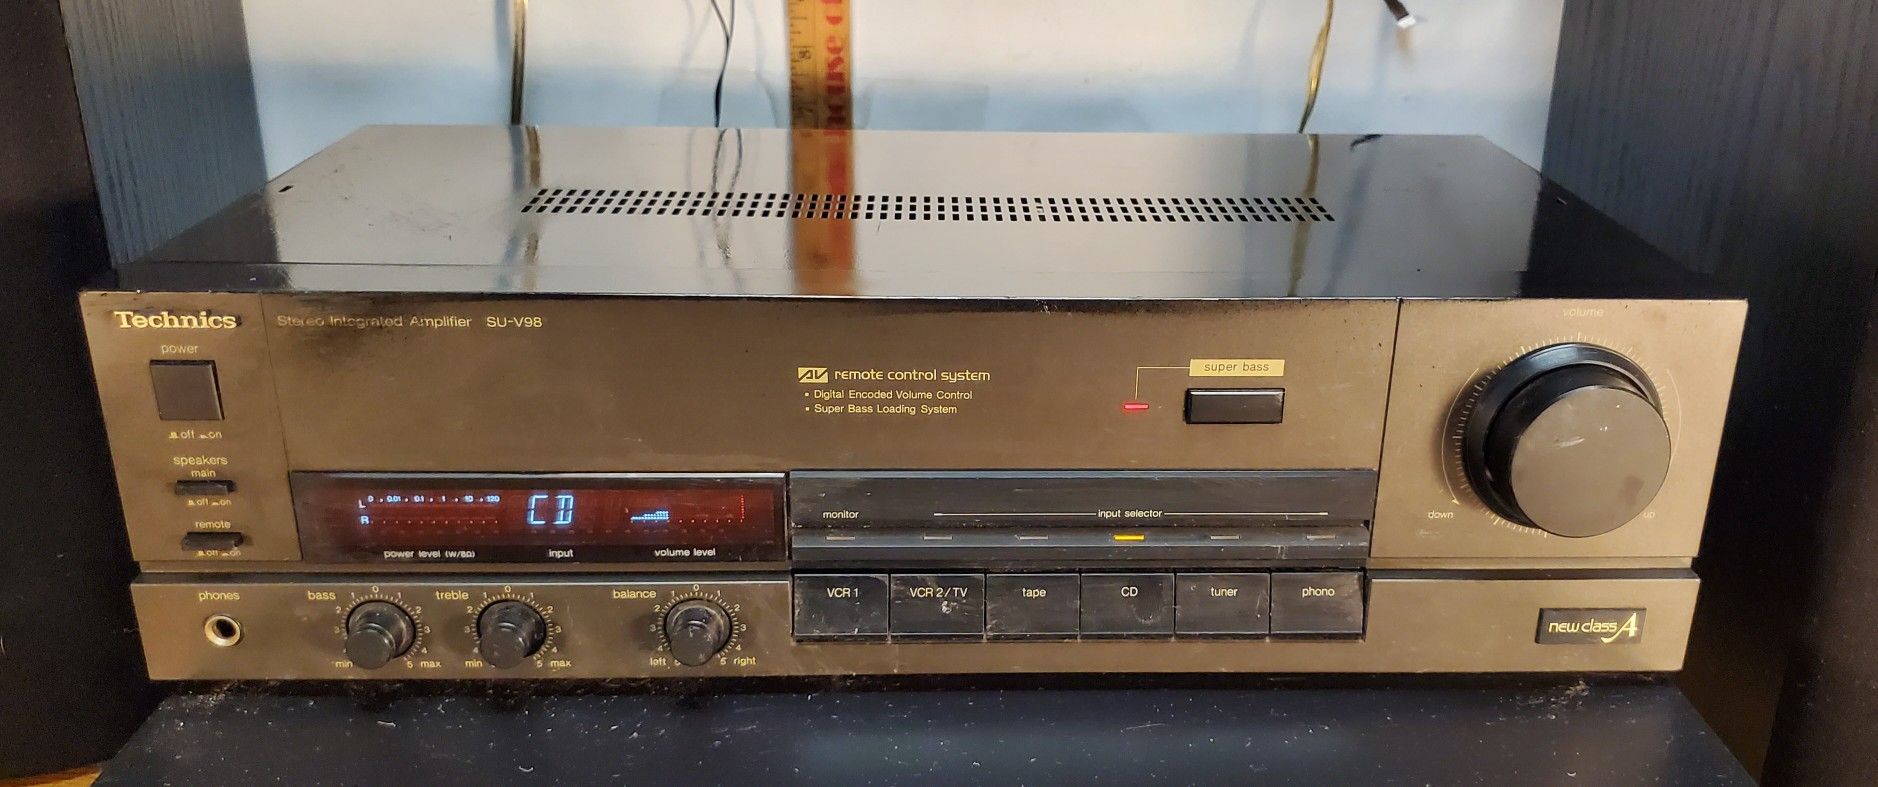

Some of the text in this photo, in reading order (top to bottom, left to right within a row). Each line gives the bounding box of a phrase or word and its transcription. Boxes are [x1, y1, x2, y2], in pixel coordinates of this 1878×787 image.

[1562, 306, 1604, 318] volume
[114, 311, 238, 330] Technics
[277, 315, 543, 329] Stereo Integrated Amplifier SU-V98
[161, 344, 199, 355] power
[1204, 362, 1270, 374] super bass
[798, 368, 990, 384] AV remote control system
[814, 390, 973, 400] Digital Encoded Volume Control
[814, 404, 958, 416] Super Bass Loading System
[180, 430, 222, 439] off on
[173, 455, 229, 466] speakers
[191, 468, 216, 478] main
[358, 500, 366, 509] L
[526, 494, 575, 526] CD
[822, 510, 860, 519] monitor
[1098, 509, 1163, 519] input selector
[1428, 510, 1454, 519] down
[194, 520, 232, 530] remote
[360, 516, 370, 526] R
[384, 551, 414, 560] power
[418, 550, 441, 558] level
[548, 548, 574, 558] input
[654, 548, 716, 558] volume level
[372, 585, 380, 593] 0
[504, 585, 512, 593] 0
[693, 584, 700, 592] 0
[827, 588, 858, 598] VCR 1
[910, 588, 934, 598] VCR
[1121, 586, 1138, 597] CD
[1210, 588, 1238, 597] tuner
[1302, 586, 1335, 598] phono
[198, 591, 240, 601] phones
[307, 590, 336, 600] bass
[436, 590, 470, 600] treble
[612, 589, 657, 599] balance
[1022, 588, 1046, 599] tape
[336, 606, 342, 614] 2
[415, 606, 422, 614] 2
[466, 606, 474, 614] 2
[546, 605, 554, 614] 2
[734, 604, 741, 612] 2
[424, 626, 431, 634] 3
[554, 625, 562, 633] 3
[1548, 612, 1638, 644] new class A
[335, 660, 354, 668] min
[406, 660, 414, 669] 5
[464, 659, 483, 668] min
[536, 660, 543, 668] 5
[650, 657, 667, 666] left
[720, 657, 727, 665] 5
[734, 656, 757, 668] right
